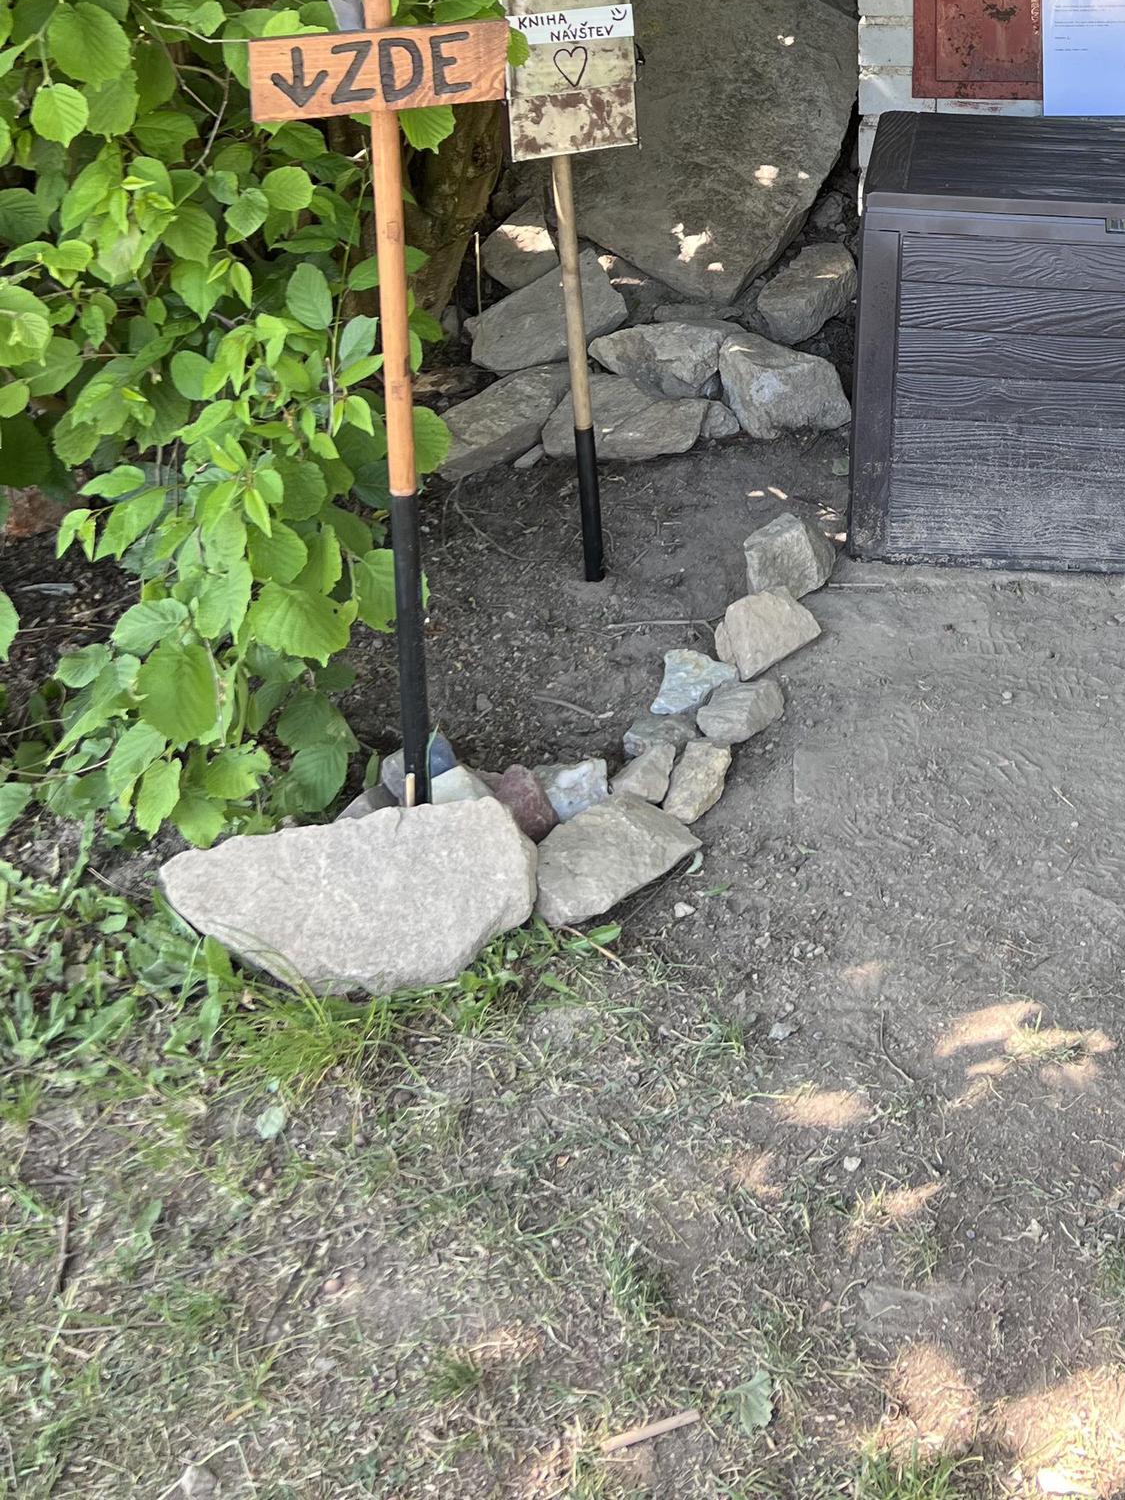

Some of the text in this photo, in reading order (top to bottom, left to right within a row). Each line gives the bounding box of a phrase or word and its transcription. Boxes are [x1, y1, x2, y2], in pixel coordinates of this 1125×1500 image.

[518, 13, 567, 30] KNIHA
[551, 21, 613, 41] NÁVŠTEV
[331, 31, 472, 104] ZDE
